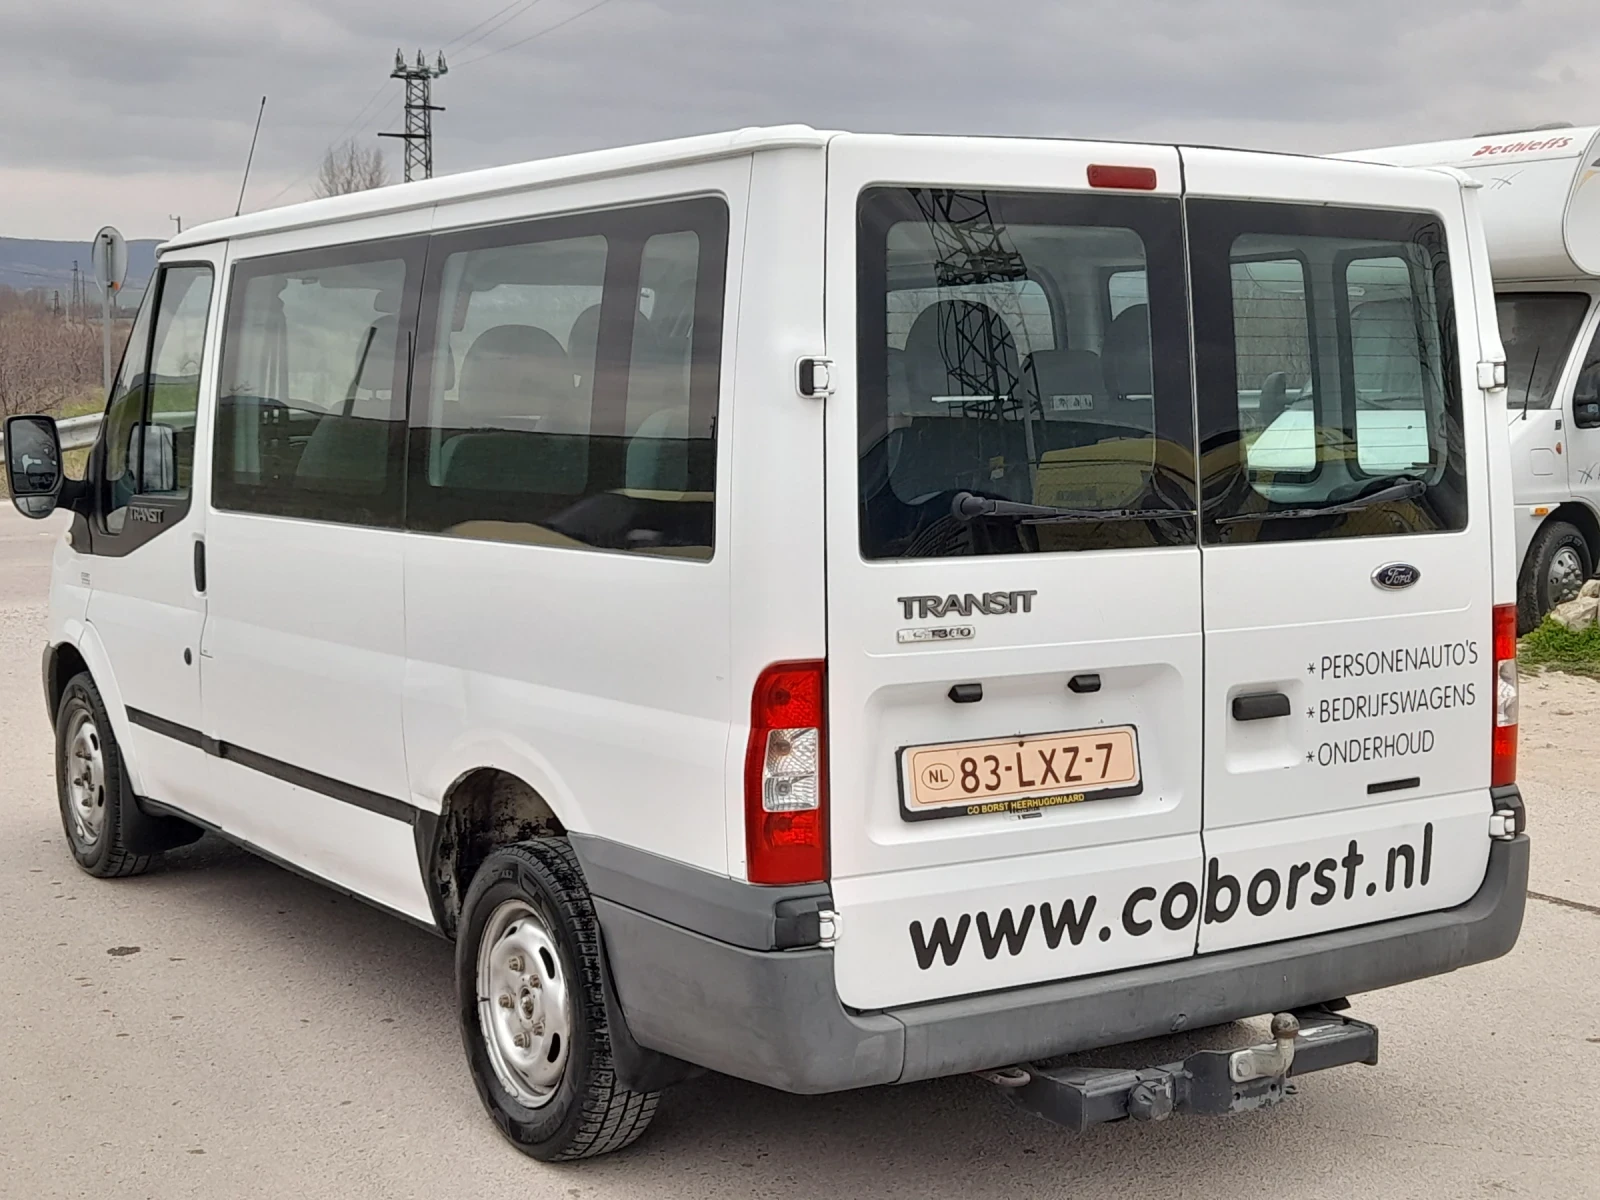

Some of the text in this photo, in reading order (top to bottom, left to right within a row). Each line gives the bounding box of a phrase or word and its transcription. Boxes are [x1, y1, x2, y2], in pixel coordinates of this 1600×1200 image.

[129, 506, 164, 523] TRANSIT
[1385, 567, 1413, 585] Ford
[897, 590, 1037, 619] TRANSIT
[1321, 640, 1478, 680] PERSONENAUTO'S
[1319, 683, 1476, 723] BEDRIJFSWAGENS
[1317, 730, 1435, 766] ONDERHOUD
[928, 743, 1113, 794] NL 83-LXZ-7
[967, 793, 1085, 815] CO BORST HEERHUGOWAARD
[909, 822, 1433, 970] www.coborst.nl
